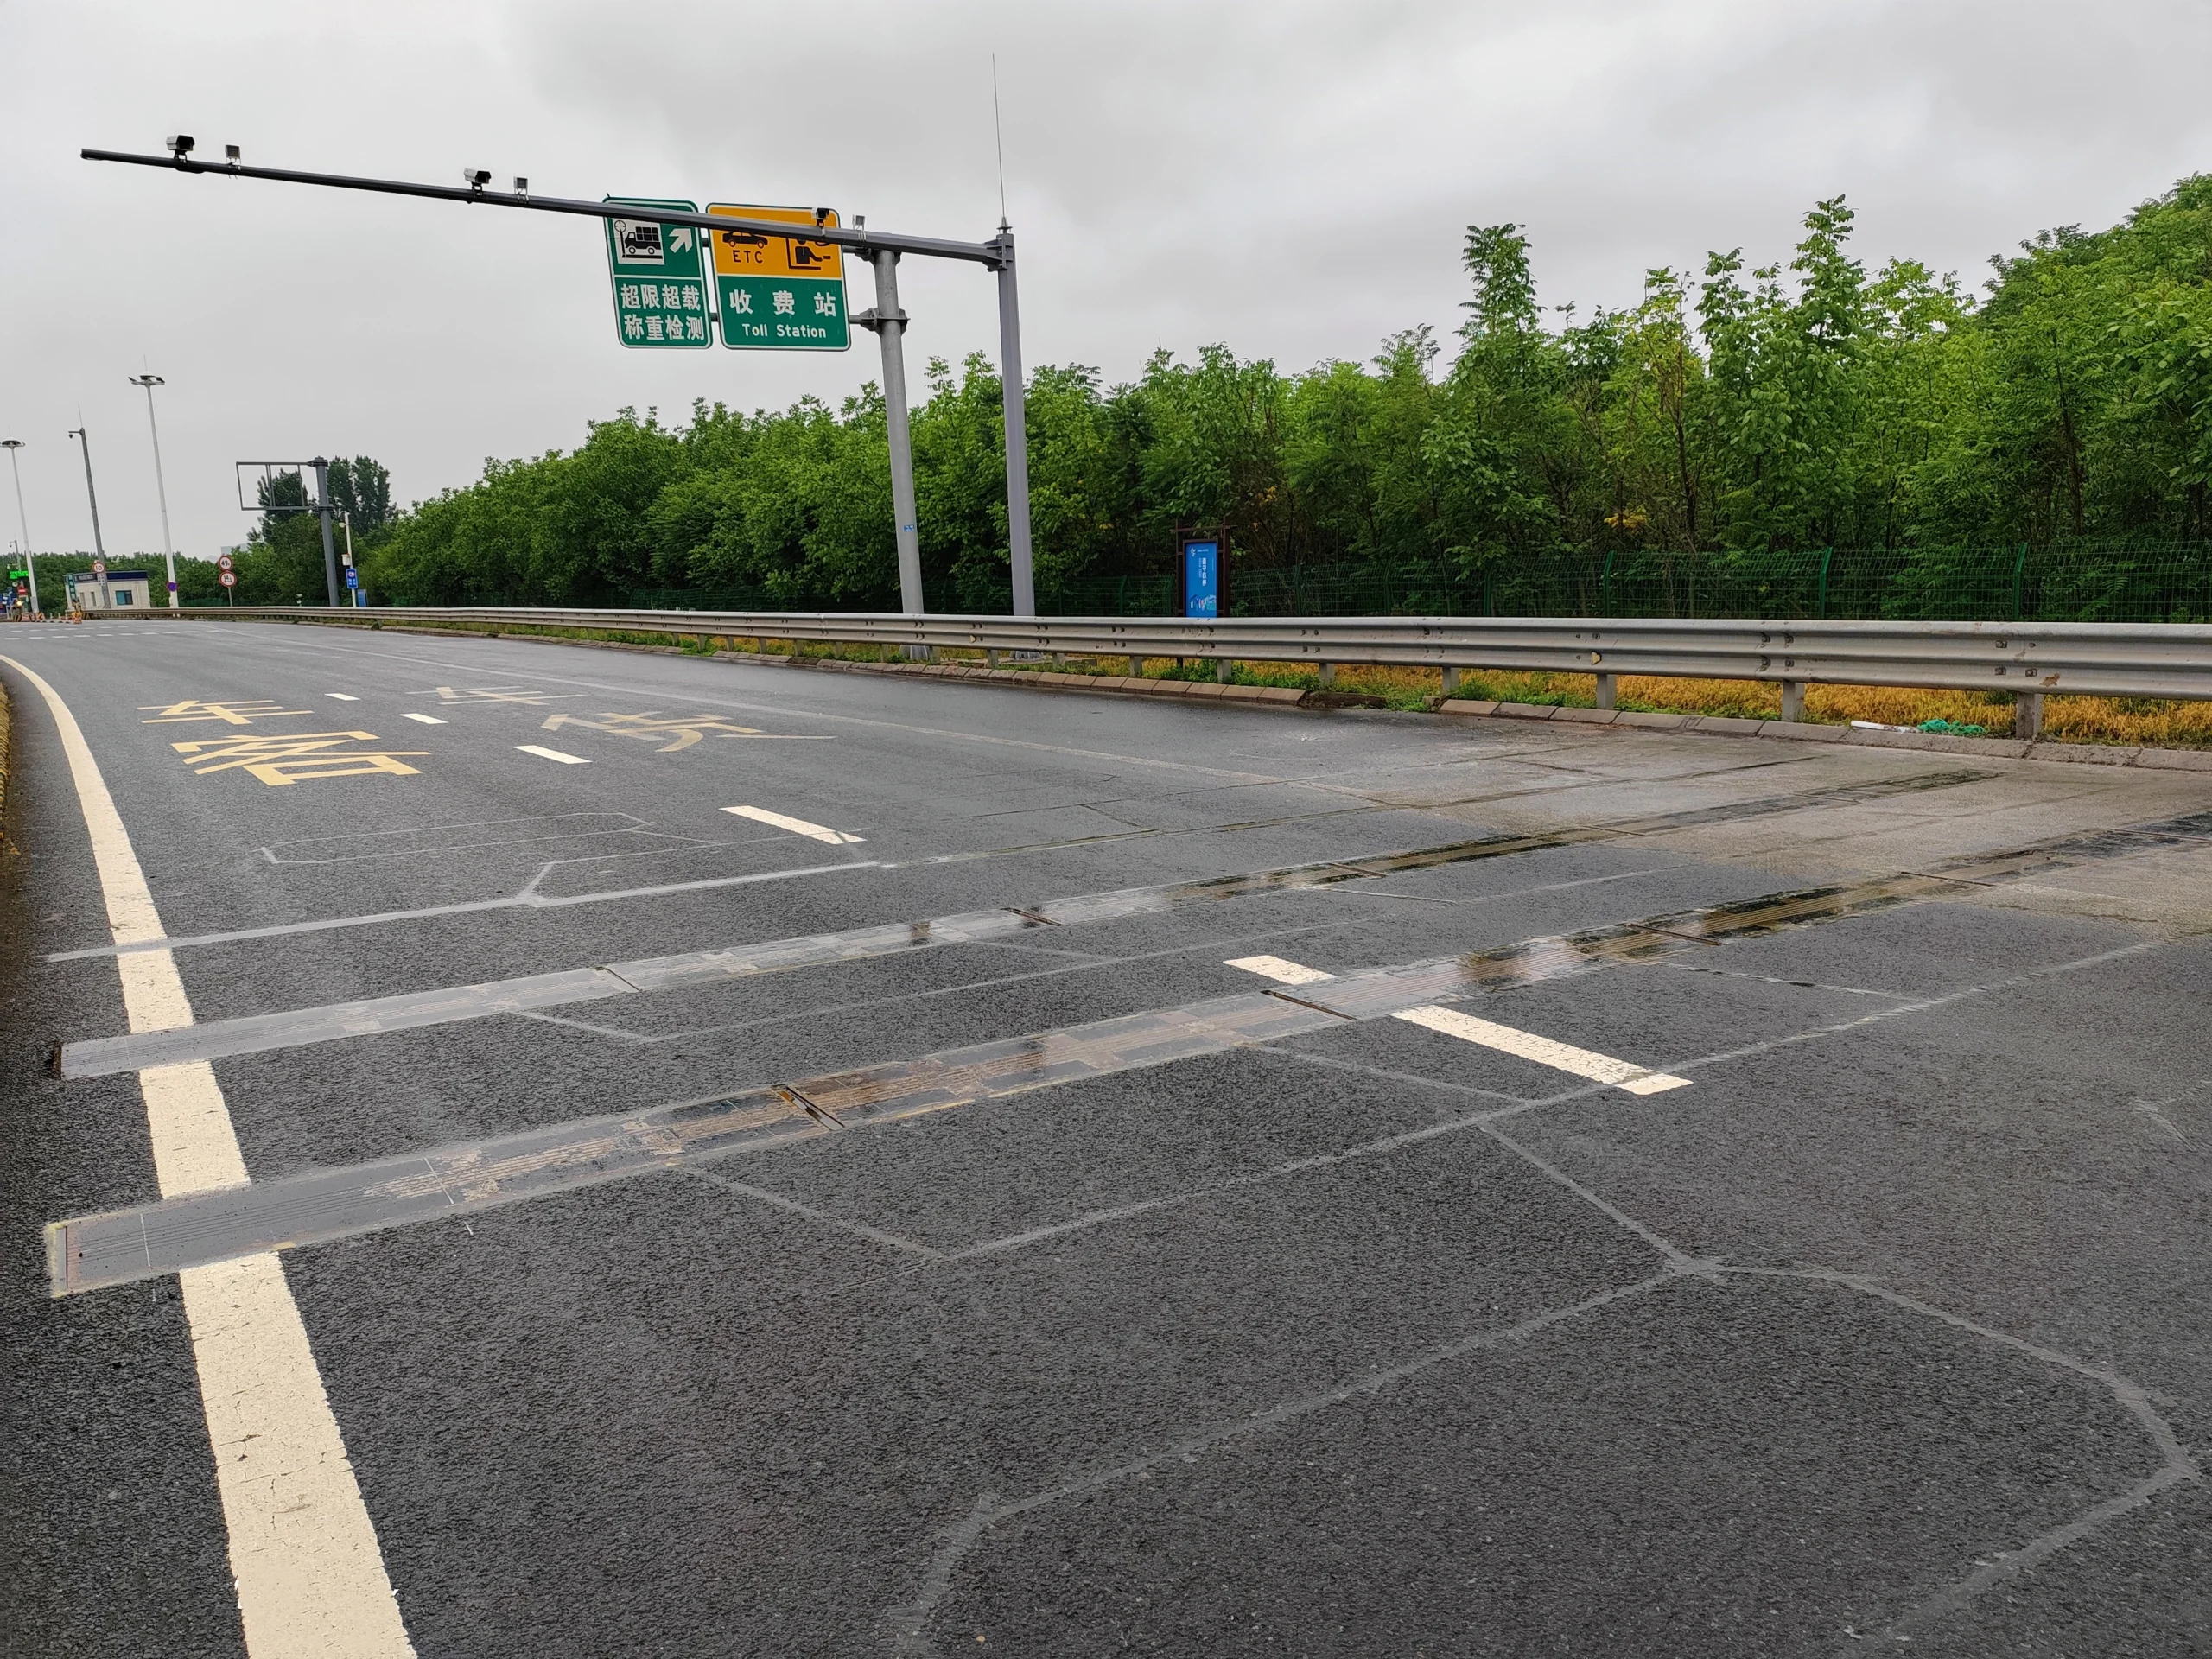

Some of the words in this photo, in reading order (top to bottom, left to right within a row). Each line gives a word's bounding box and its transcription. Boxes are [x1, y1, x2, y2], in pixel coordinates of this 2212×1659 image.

[733, 250, 764, 264] ETC
[620, 283, 701, 312] 超限超载
[728, 289, 836, 317] 收费站
[624, 313, 705, 341] 称重检测
[741, 323, 768, 337] Toll
[776, 324, 827, 338] Station
